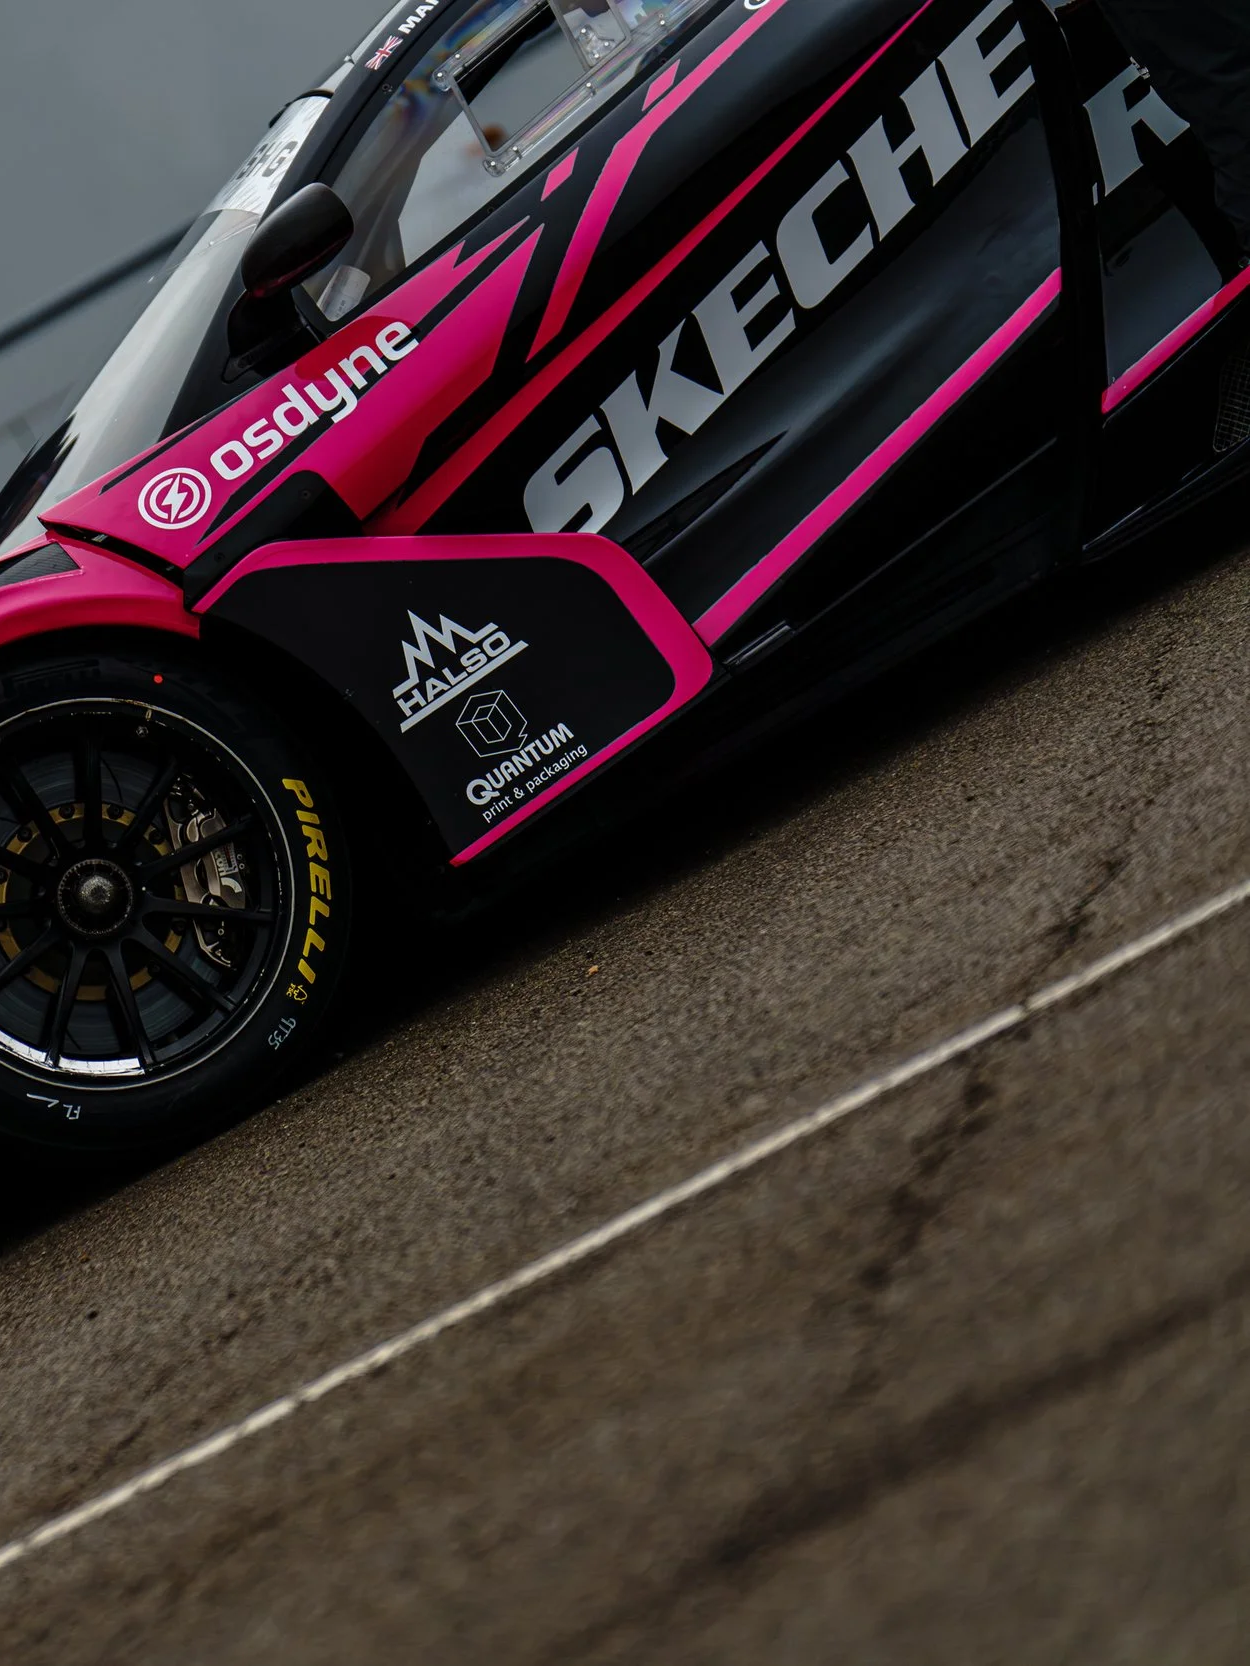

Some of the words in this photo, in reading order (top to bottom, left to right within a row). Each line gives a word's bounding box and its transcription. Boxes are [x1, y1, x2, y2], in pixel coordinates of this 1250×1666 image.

[398, 0, 439, 34] MA
[210, 321, 420, 481] osdyne
[396, 630, 511, 717] HALSO
[466, 722, 574, 805] QUANTUM
[482, 796, 513, 823] print
[513, 786, 526, 799] &
[525, 744, 588, 793] packaging
[282, 778, 332, 984] PIRELLI
